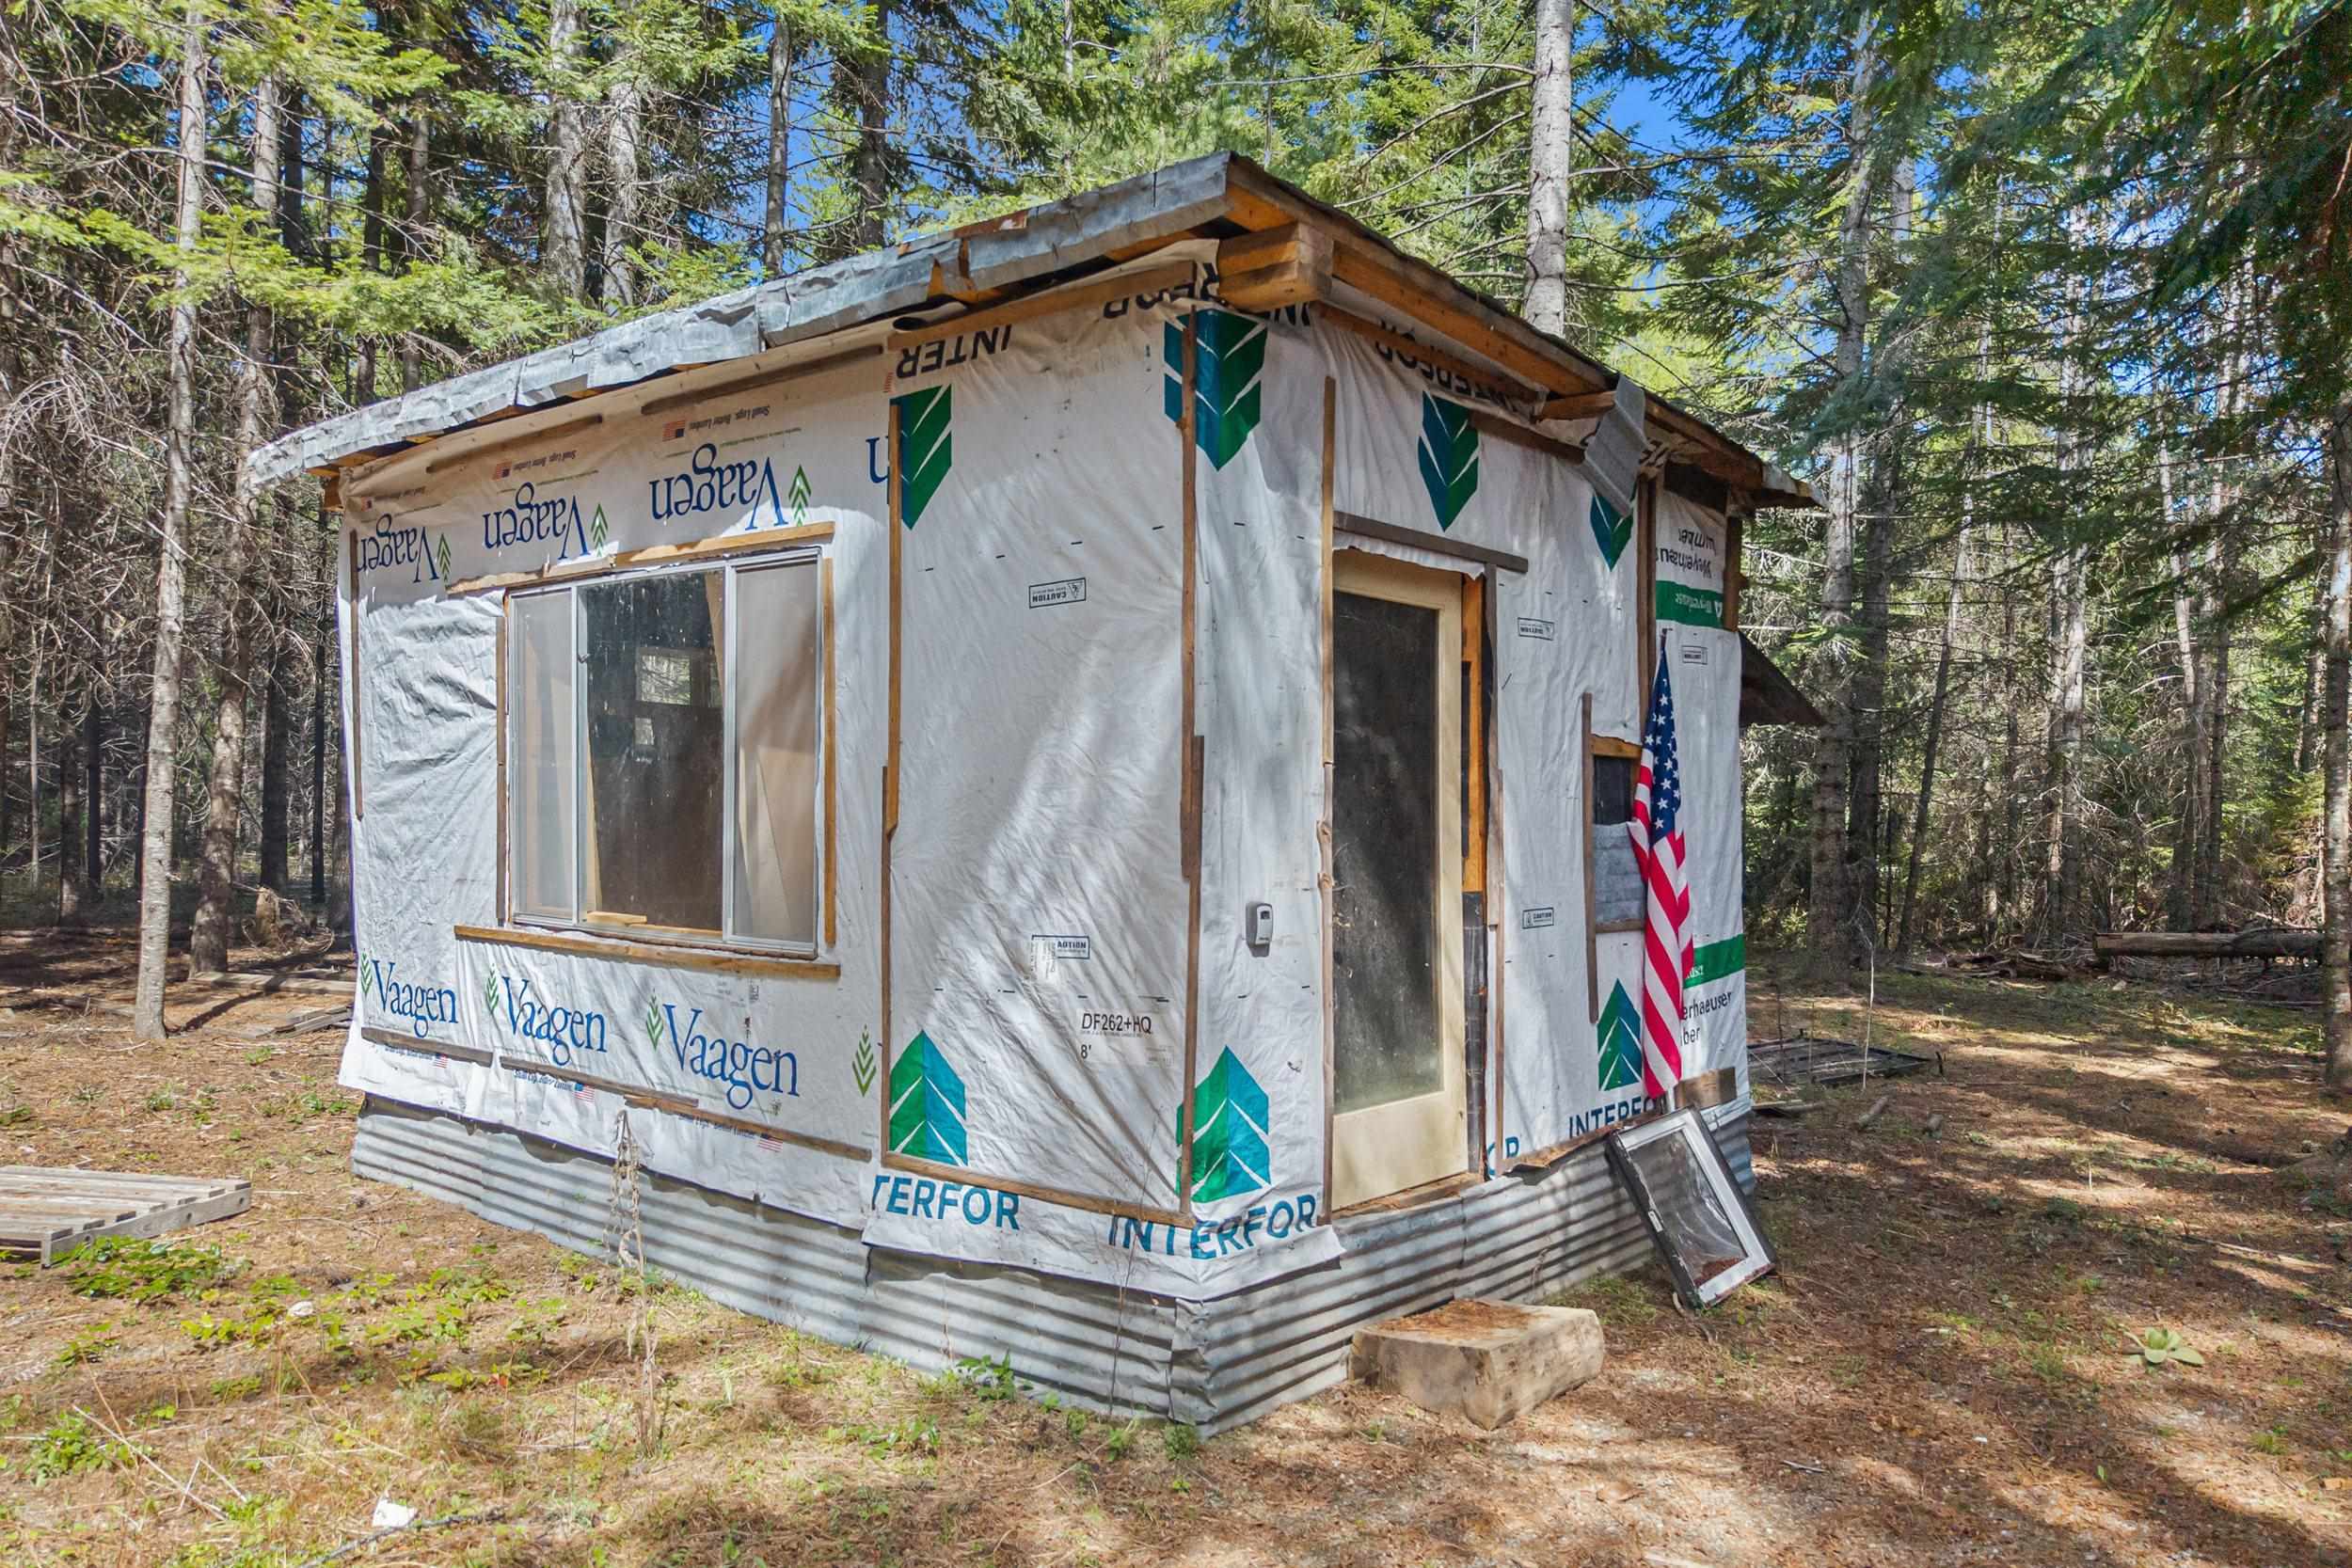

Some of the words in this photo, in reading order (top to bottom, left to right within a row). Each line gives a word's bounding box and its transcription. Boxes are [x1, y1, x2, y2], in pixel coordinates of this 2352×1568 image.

[896, 324, 1012, 379] INTER
[648, 443, 789, 531] Vaagen
[356, 514, 440, 584] Vaagen
[483, 483, 590, 560] Vaagen
[1032, 592, 1067, 603] CAUTION
[1057, 941, 1088, 949] AUTION
[372, 959, 459, 1038] Vaagen
[501, 974, 609, 1067] Vaagen
[1081, 1012, 1152, 1035] DF262+HQ
[1682, 990, 1733, 1021] erhaeuser
[663, 1004, 801, 1111] Vaagen
[1680, 1026, 1701, 1046] ber
